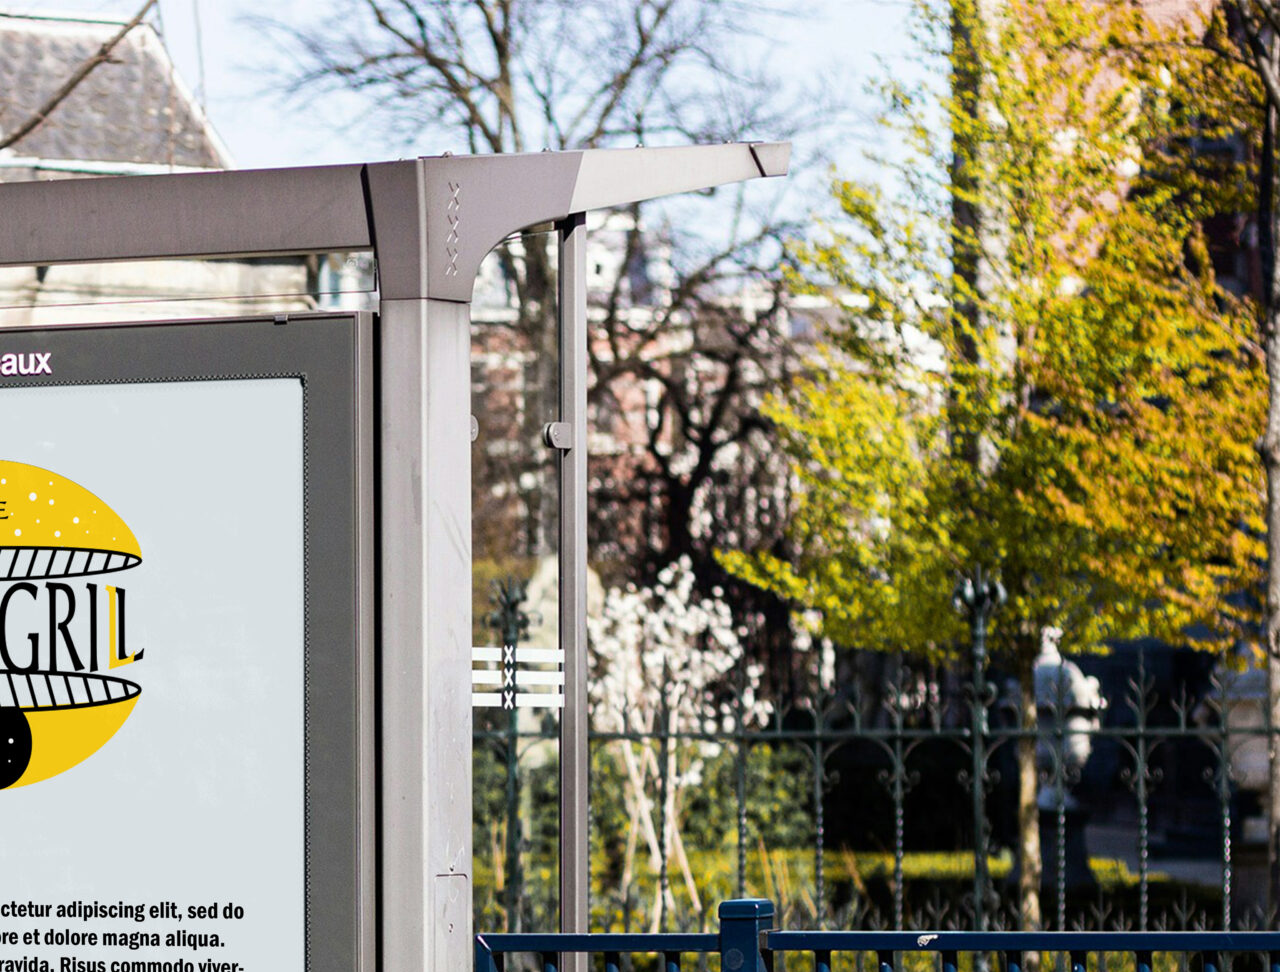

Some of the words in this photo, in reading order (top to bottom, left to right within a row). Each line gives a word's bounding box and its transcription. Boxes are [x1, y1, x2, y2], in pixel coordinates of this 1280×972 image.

[56, 900, 146, 923] adipiscing
[148, 901, 183, 923] elit,
[187, 902, 218, 920] sed
[222, 902, 245, 920] do
[22, 928, 41, 946] et
[43, 928, 98, 946] dolore
[102, 931, 161, 951] magna
[165, 929, 225, 951] aliqua.
